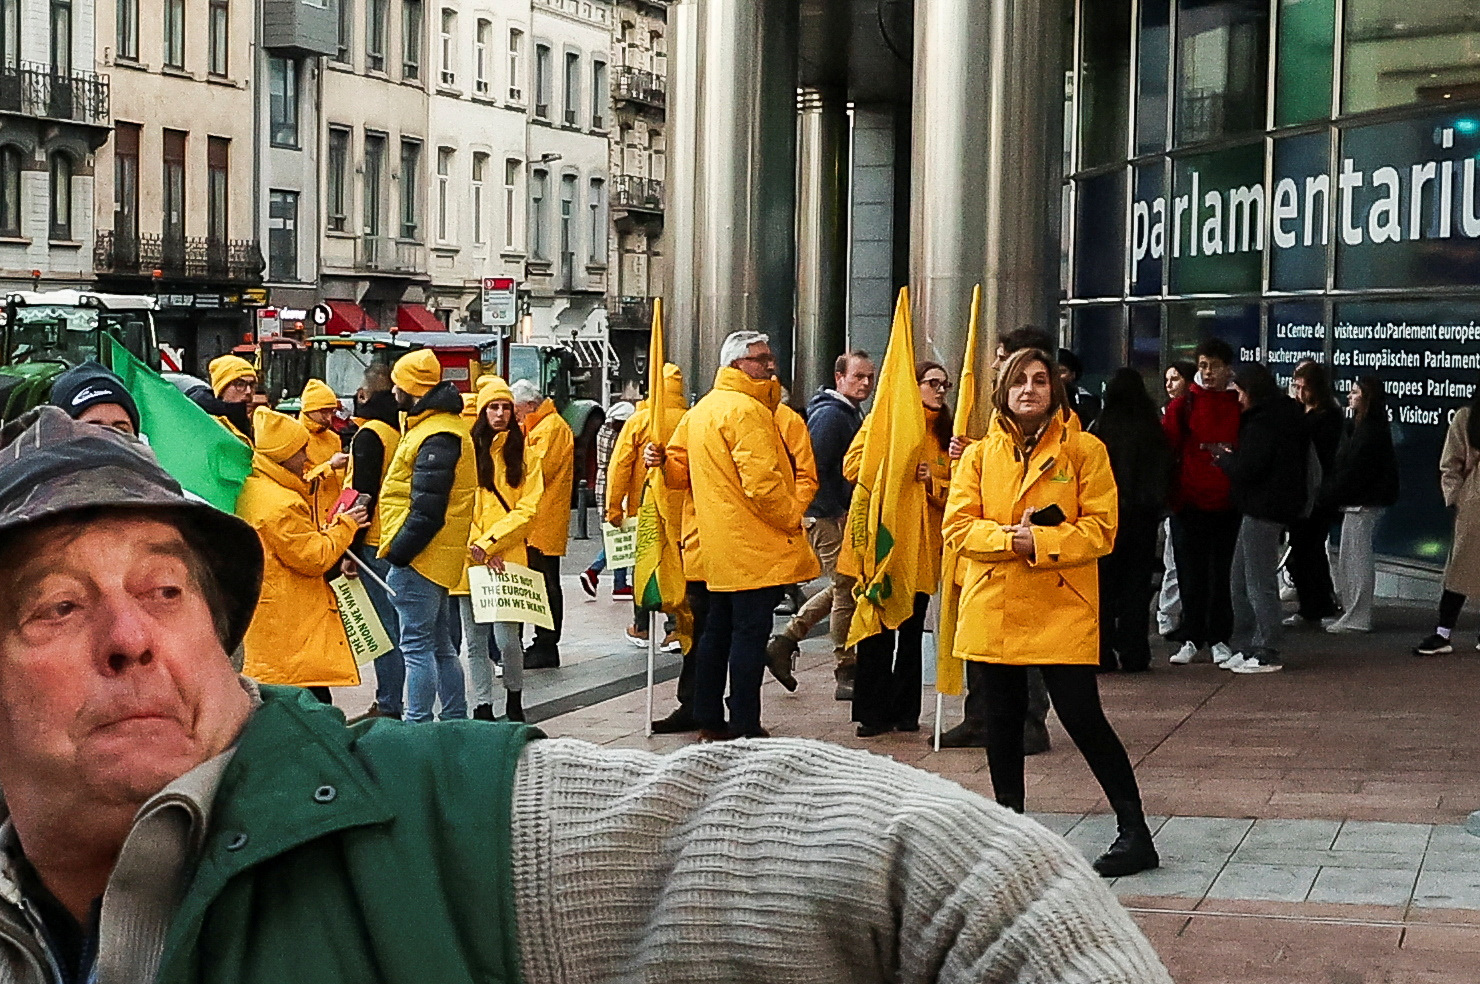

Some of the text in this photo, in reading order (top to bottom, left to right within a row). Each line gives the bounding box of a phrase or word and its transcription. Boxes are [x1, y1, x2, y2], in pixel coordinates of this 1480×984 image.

[1276, 323, 1286, 338] Le
[1287, 322, 1313, 339] Centre
[1314, 322, 1325, 338] de
[1334, 322, 1373, 339] visiteurs
[1374, 322, 1386, 339] du
[1387, 322, 1437, 340] Parlement
[1240, 347, 1254, 362] Das
[1333, 349, 1351, 366] des
[1353, 348, 1420, 371] Europäischen
[1424, 350, 1480, 370] Parlament
[1427, 378, 1477, 399] Parleme
[1399, 404, 1442, 425] Visitors'
[482, 585, 500, 596] THE
[480, 597, 510, 608] UNION
[512, 598, 525, 609] WE
[338, 583, 379, 653] UNION WE WANT
[351, 637, 366, 656] THE
